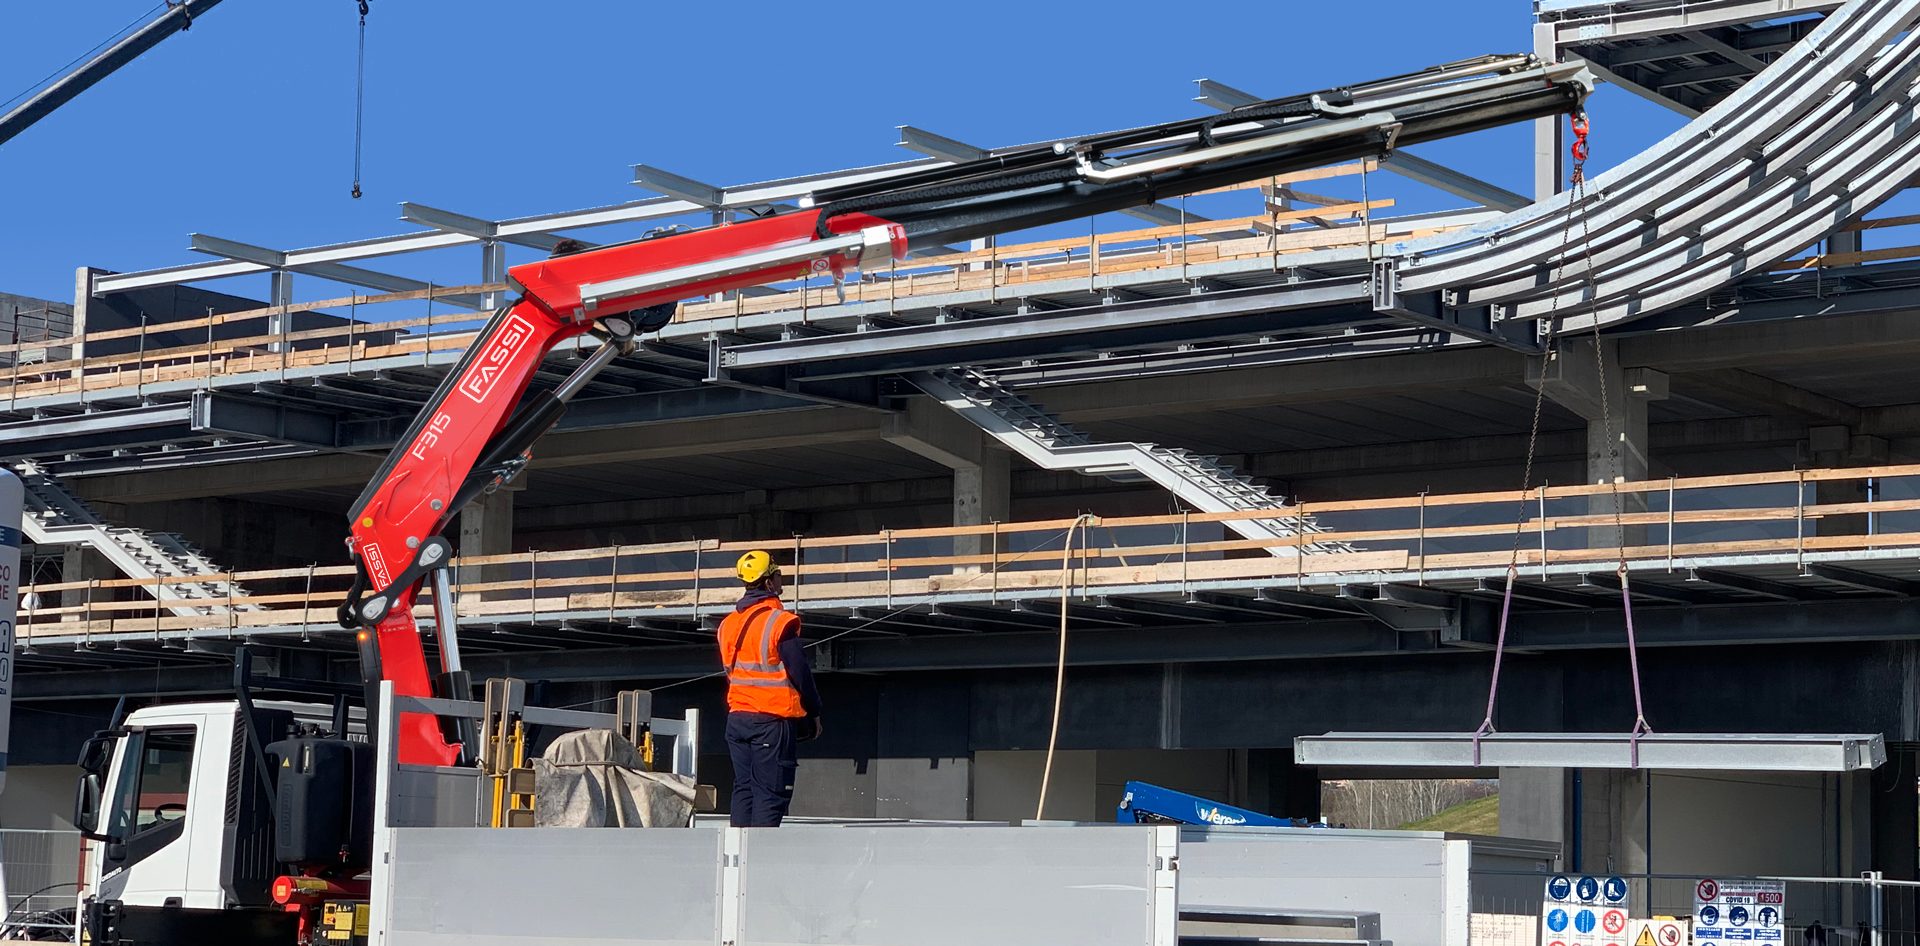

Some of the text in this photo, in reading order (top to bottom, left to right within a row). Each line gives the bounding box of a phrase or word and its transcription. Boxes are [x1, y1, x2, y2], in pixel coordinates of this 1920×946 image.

[468, 323, 526, 394] FASSI
[411, 411, 452, 461] F315
[367, 547, 390, 588] FASSI
[1744, 896, 1751, 904] 19
[1760, 893, 1780, 903] 1500
